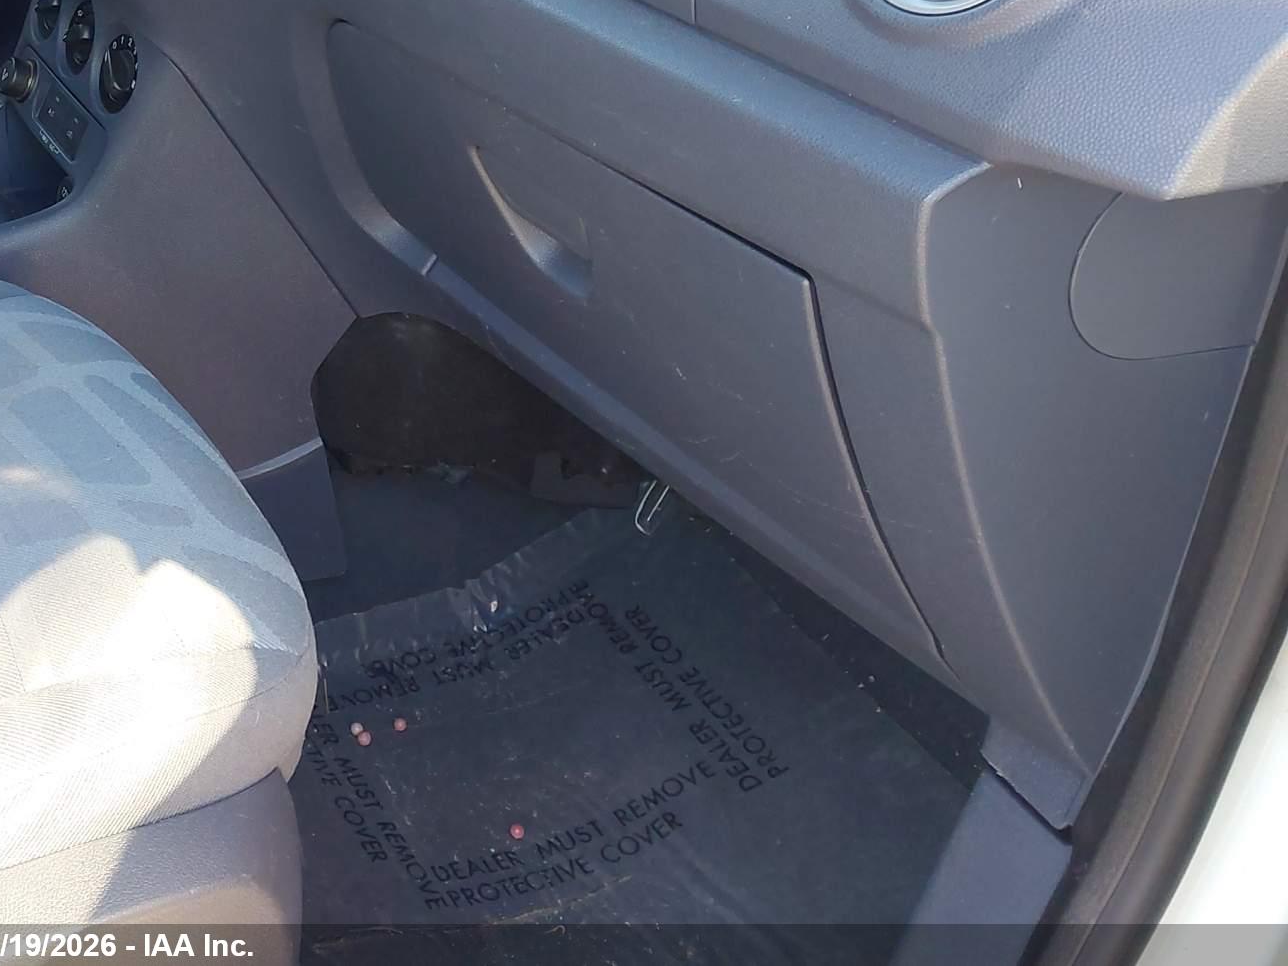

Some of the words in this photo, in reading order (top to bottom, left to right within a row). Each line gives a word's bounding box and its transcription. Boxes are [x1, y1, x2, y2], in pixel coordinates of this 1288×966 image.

[567, 579, 640, 655] REMOVE
[624, 604, 683, 664] COVER
[634, 661, 693, 711] MUST
[677, 666, 790, 779] PROTECTIVE
[688, 718, 763, 792] DEALER
[334, 795, 389, 863] COVER
[334, 757, 384, 810] MUST
[375, 821, 448, 910] REMOVE
[430, 850, 525, 884] DEALER
[535, 819, 605, 859] MUST
[612, 759, 716, 827] REMOVE
[450, 856, 595, 909] PROTECTIVE
[600, 810, 683, 864] COVER
